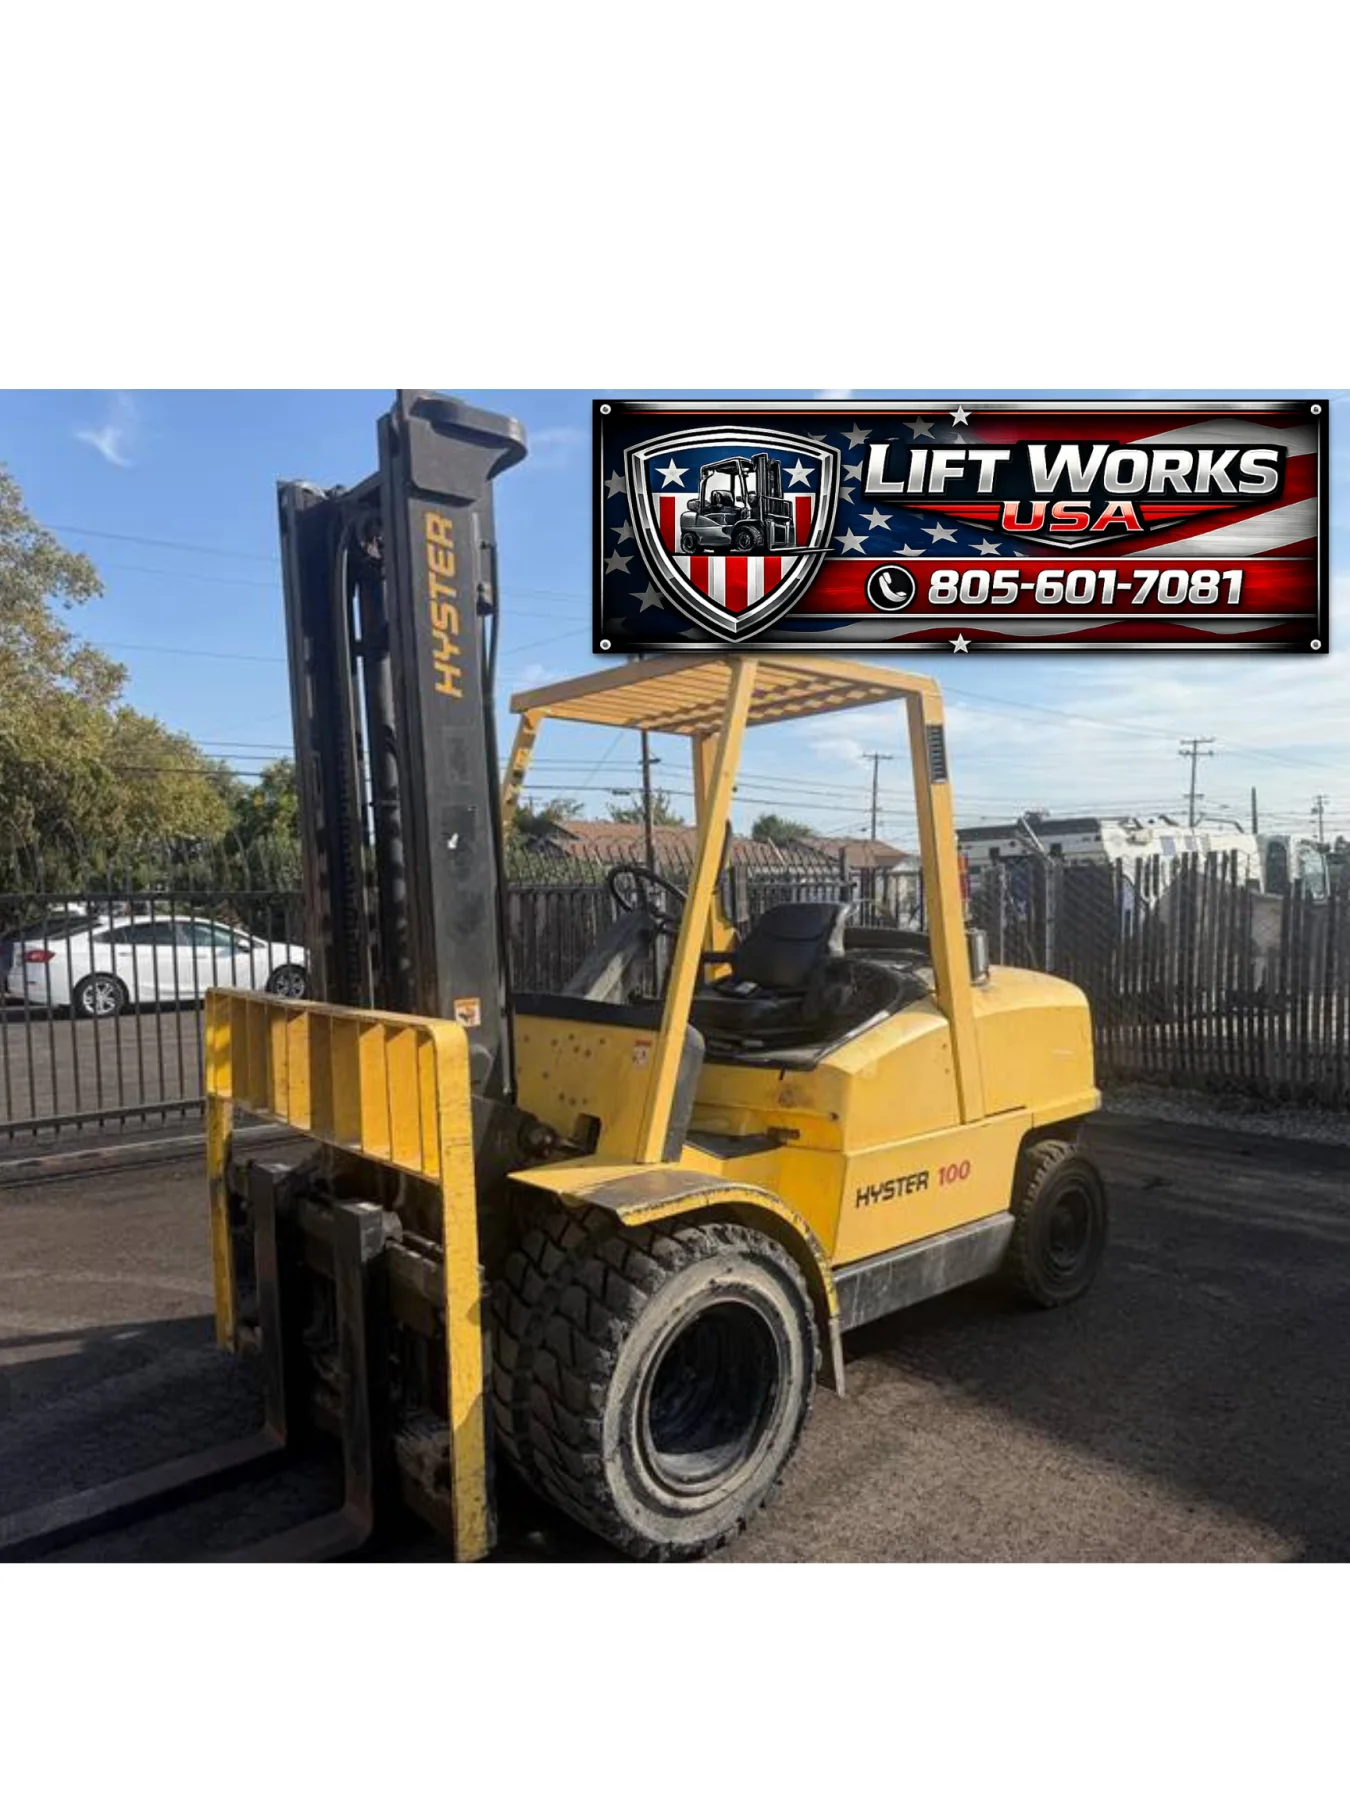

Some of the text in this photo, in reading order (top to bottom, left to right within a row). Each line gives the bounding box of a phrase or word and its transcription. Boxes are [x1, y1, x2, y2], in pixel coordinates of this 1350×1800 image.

[426, 512, 462, 698] HYSTER
[855, 1160, 971, 1208] HYSTER 100
